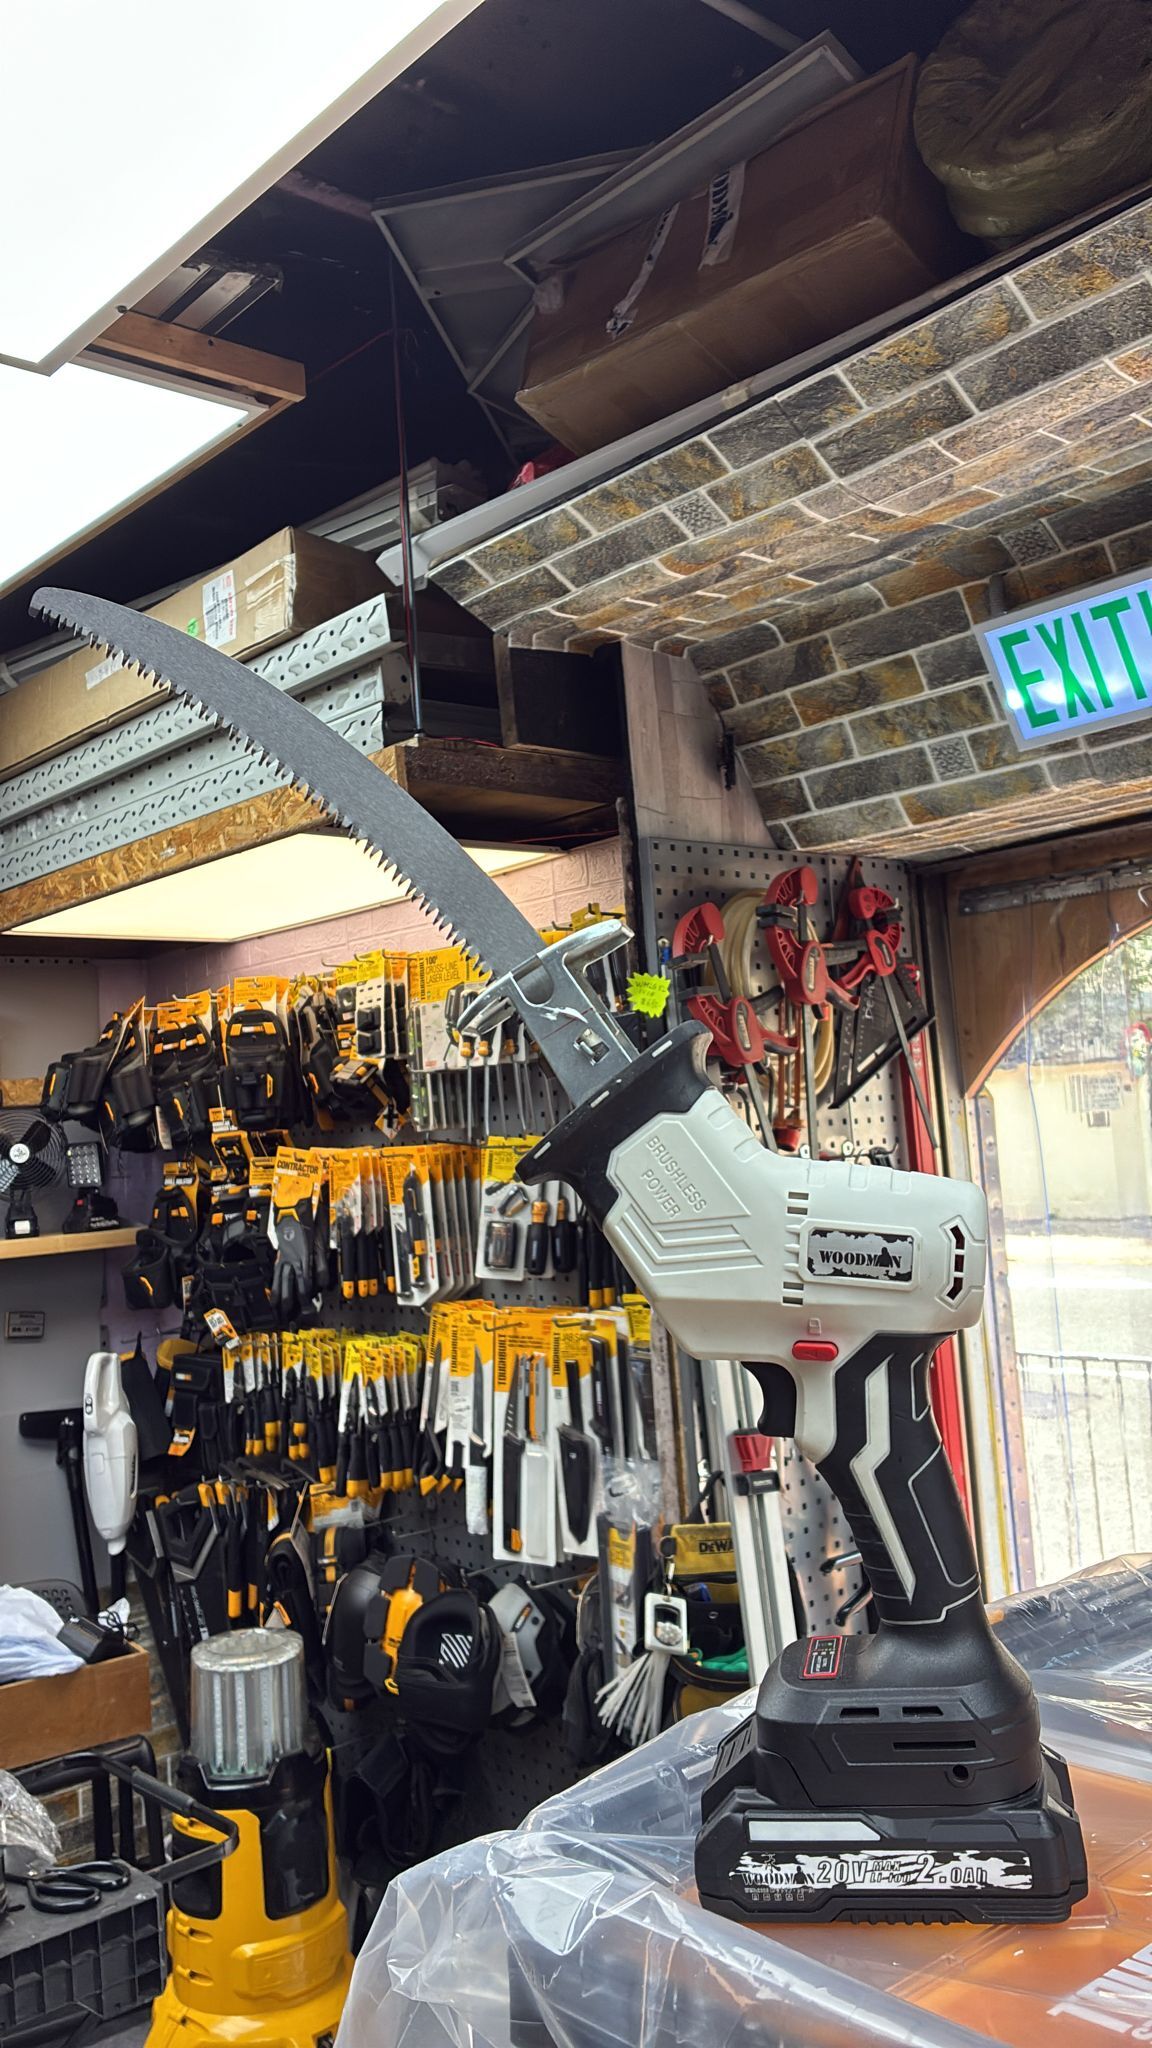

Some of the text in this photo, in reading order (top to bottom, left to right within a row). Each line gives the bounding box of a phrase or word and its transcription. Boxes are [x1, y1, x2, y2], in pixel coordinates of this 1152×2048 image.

[998, 596, 1147, 729] EXIT
[277, 1159, 319, 1175] CONTRACTOR
[646, 1136, 707, 1212] BRUSHLESS
[641, 1169, 681, 1218] POWER
[816, 1860, 868, 1884] 20V
[872, 1860, 902, 1872] MAX
